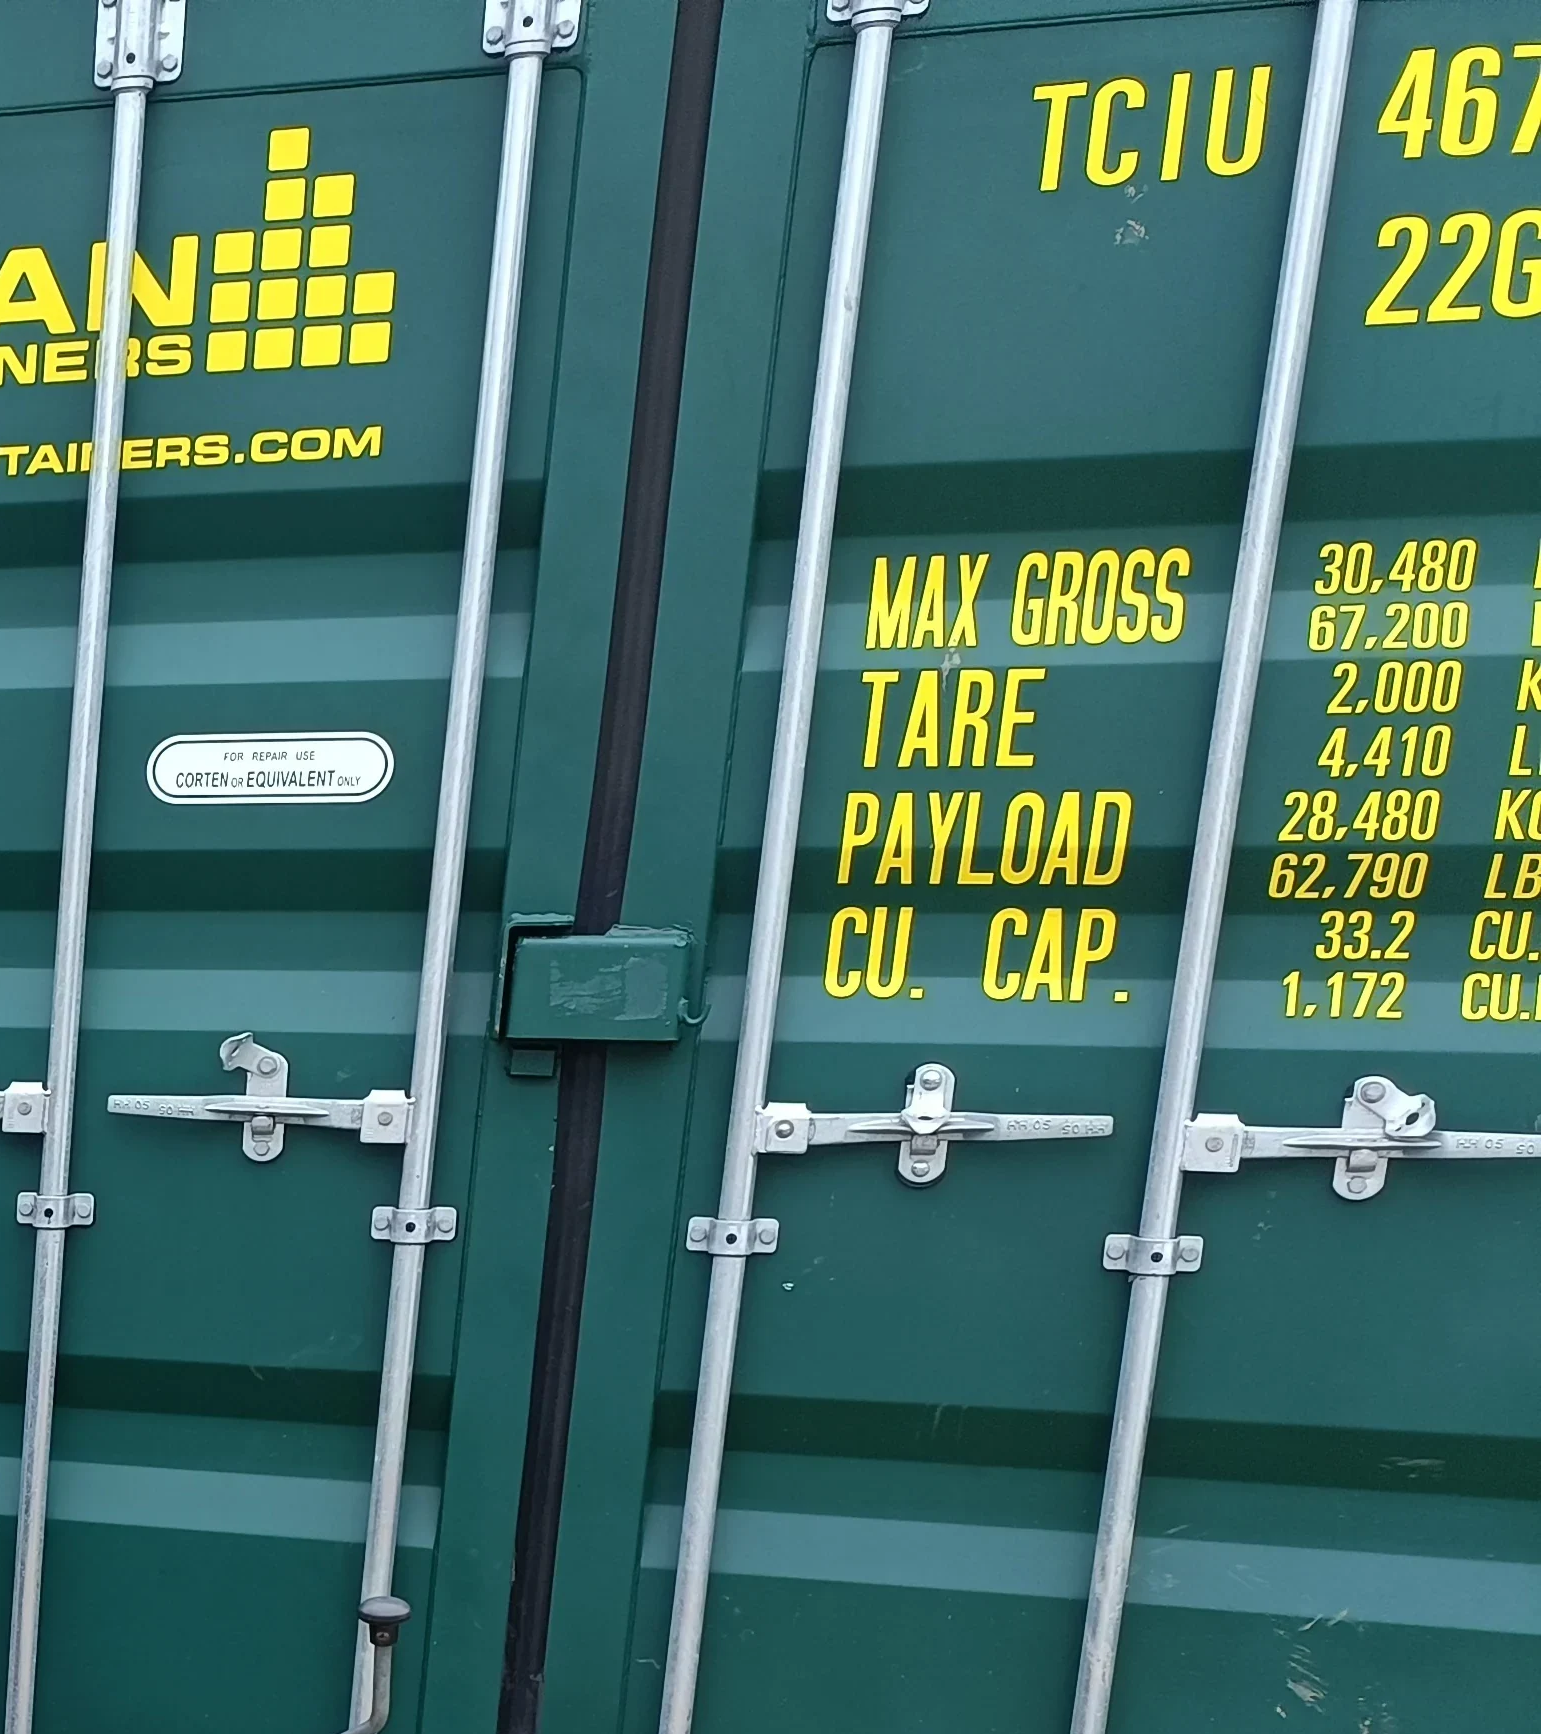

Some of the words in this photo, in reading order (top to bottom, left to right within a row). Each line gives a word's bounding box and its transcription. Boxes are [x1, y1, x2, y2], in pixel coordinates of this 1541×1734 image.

[1034, 66, 1272, 191] TCIU
[1366, 209, 1541, 325] 22G
[867, 554, 990, 649] MAX
[1012, 547, 1192, 646] GROSS
[1314, 539, 1478, 595] 30,480
[1308, 602, 1470, 652] 67,200
[863, 668, 1046, 767] TARE
[1326, 660, 1463, 714] 2,000
[176, 772, 229, 789] CORTEN
[231, 777, 244, 788] OR
[246, 769, 336, 788] EQUIVALENT
[337, 776, 361, 787] ONLY
[224, 752, 244, 762] FOR
[252, 751, 288, 761] REPAIR
[295, 750, 316, 761] USE
[1317, 725, 1452, 777] 4,410
[838, 791, 1133, 885] PAYLOAD
[1278, 790, 1442, 841] 28,480
[1267, 853, 1430, 899] 62,790
[825, 907, 924, 998] CU.
[983, 908, 1128, 1002] CAP.
[1315, 910, 1416, 960] 33.2
[1283, 972, 1406, 1019] 1,172
